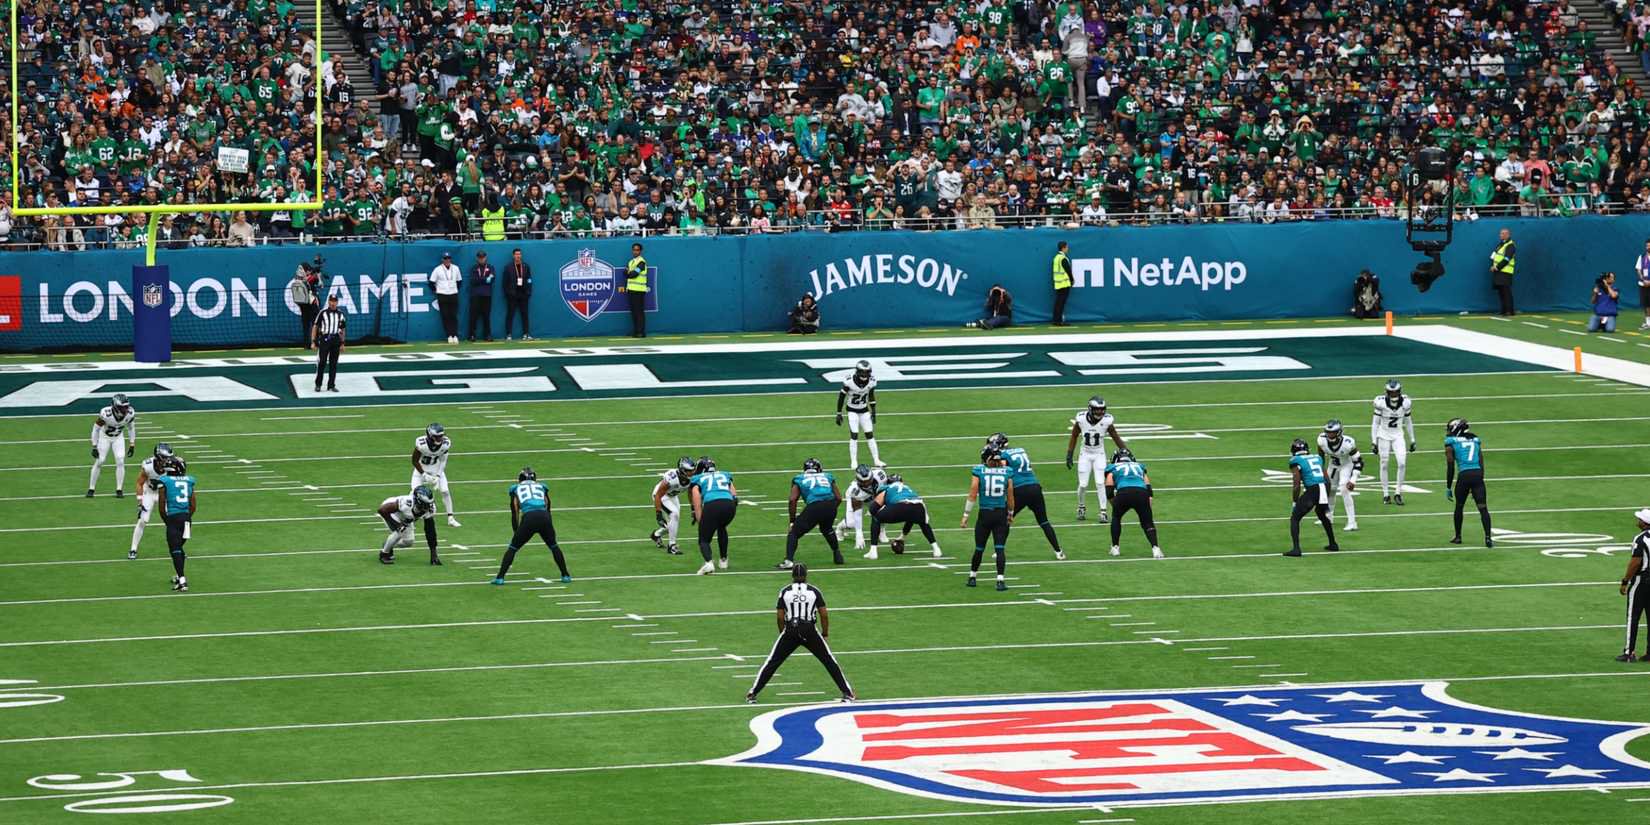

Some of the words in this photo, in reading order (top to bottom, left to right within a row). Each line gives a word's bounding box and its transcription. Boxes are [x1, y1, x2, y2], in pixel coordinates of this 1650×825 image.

[99, 147, 114, 161] 62
[900, 182, 913, 196] 26
[809, 254, 963, 300] JAMESON
[1113, 256, 1247, 291] NetApp
[284, 273, 439, 316] AME
[564, 282, 611, 291] LONDON
[851, 393, 868, 405] 24
[1388, 416, 1398, 428] 2
[1084, 432, 1101, 447] 11
[1462, 441, 1475, 461] 7
[1308, 458, 1324, 477] 5
[700, 473, 731, 491] 72
[984, 475, 1005, 497] 16
[174, 481, 189, 503] 3
[517, 484, 546, 503] 85
[792, 594, 807, 602] 20
[853, 703, 1329, 793] NFL
[26, 769, 235, 814] 50
